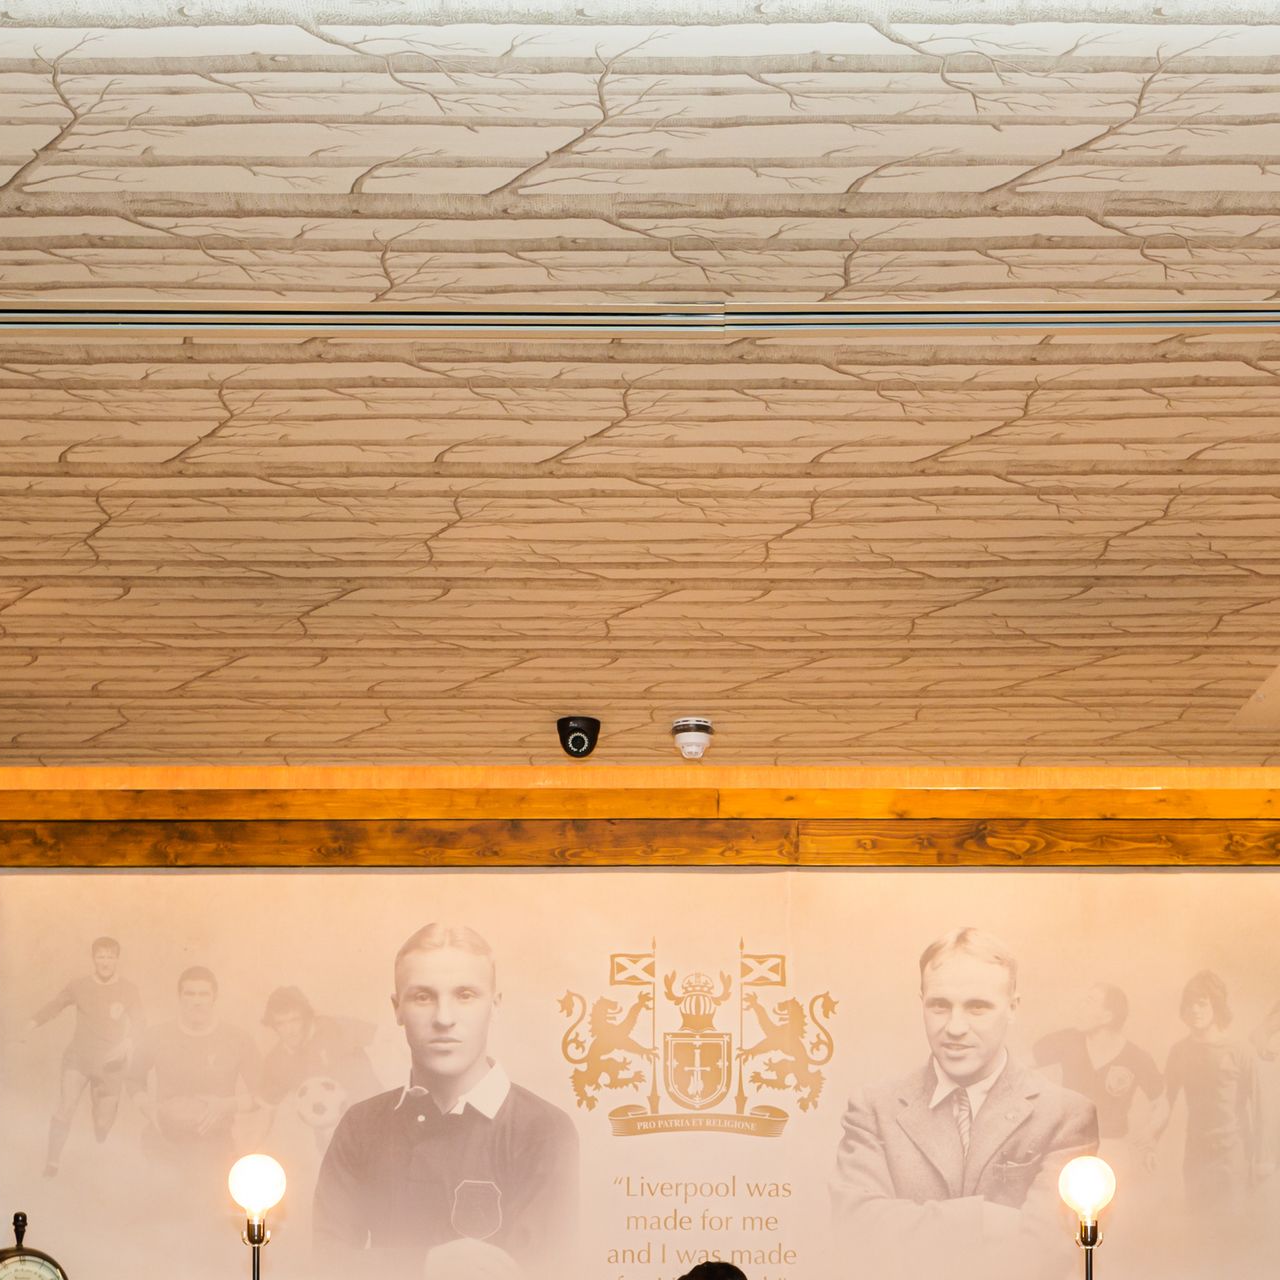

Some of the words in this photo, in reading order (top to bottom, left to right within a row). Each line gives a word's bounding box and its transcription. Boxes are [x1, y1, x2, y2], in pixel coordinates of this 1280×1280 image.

[636, 1120, 657, 1130] PRO
[658, 1119, 690, 1128] PATRIA
[691, 1118, 704, 1128] ET
[705, 1119, 757, 1131] RELIGIONE
[745, 1182, 793, 1198] was
[625, 1208, 692, 1231] made
[701, 1208, 733, 1231] for
[742, 1215, 779, 1231] me
[607, 1242, 651, 1264] and
[661, 1243, 666, 1264] I
[675, 1249, 721, 1264] was
[730, 1242, 797, 1265] made
